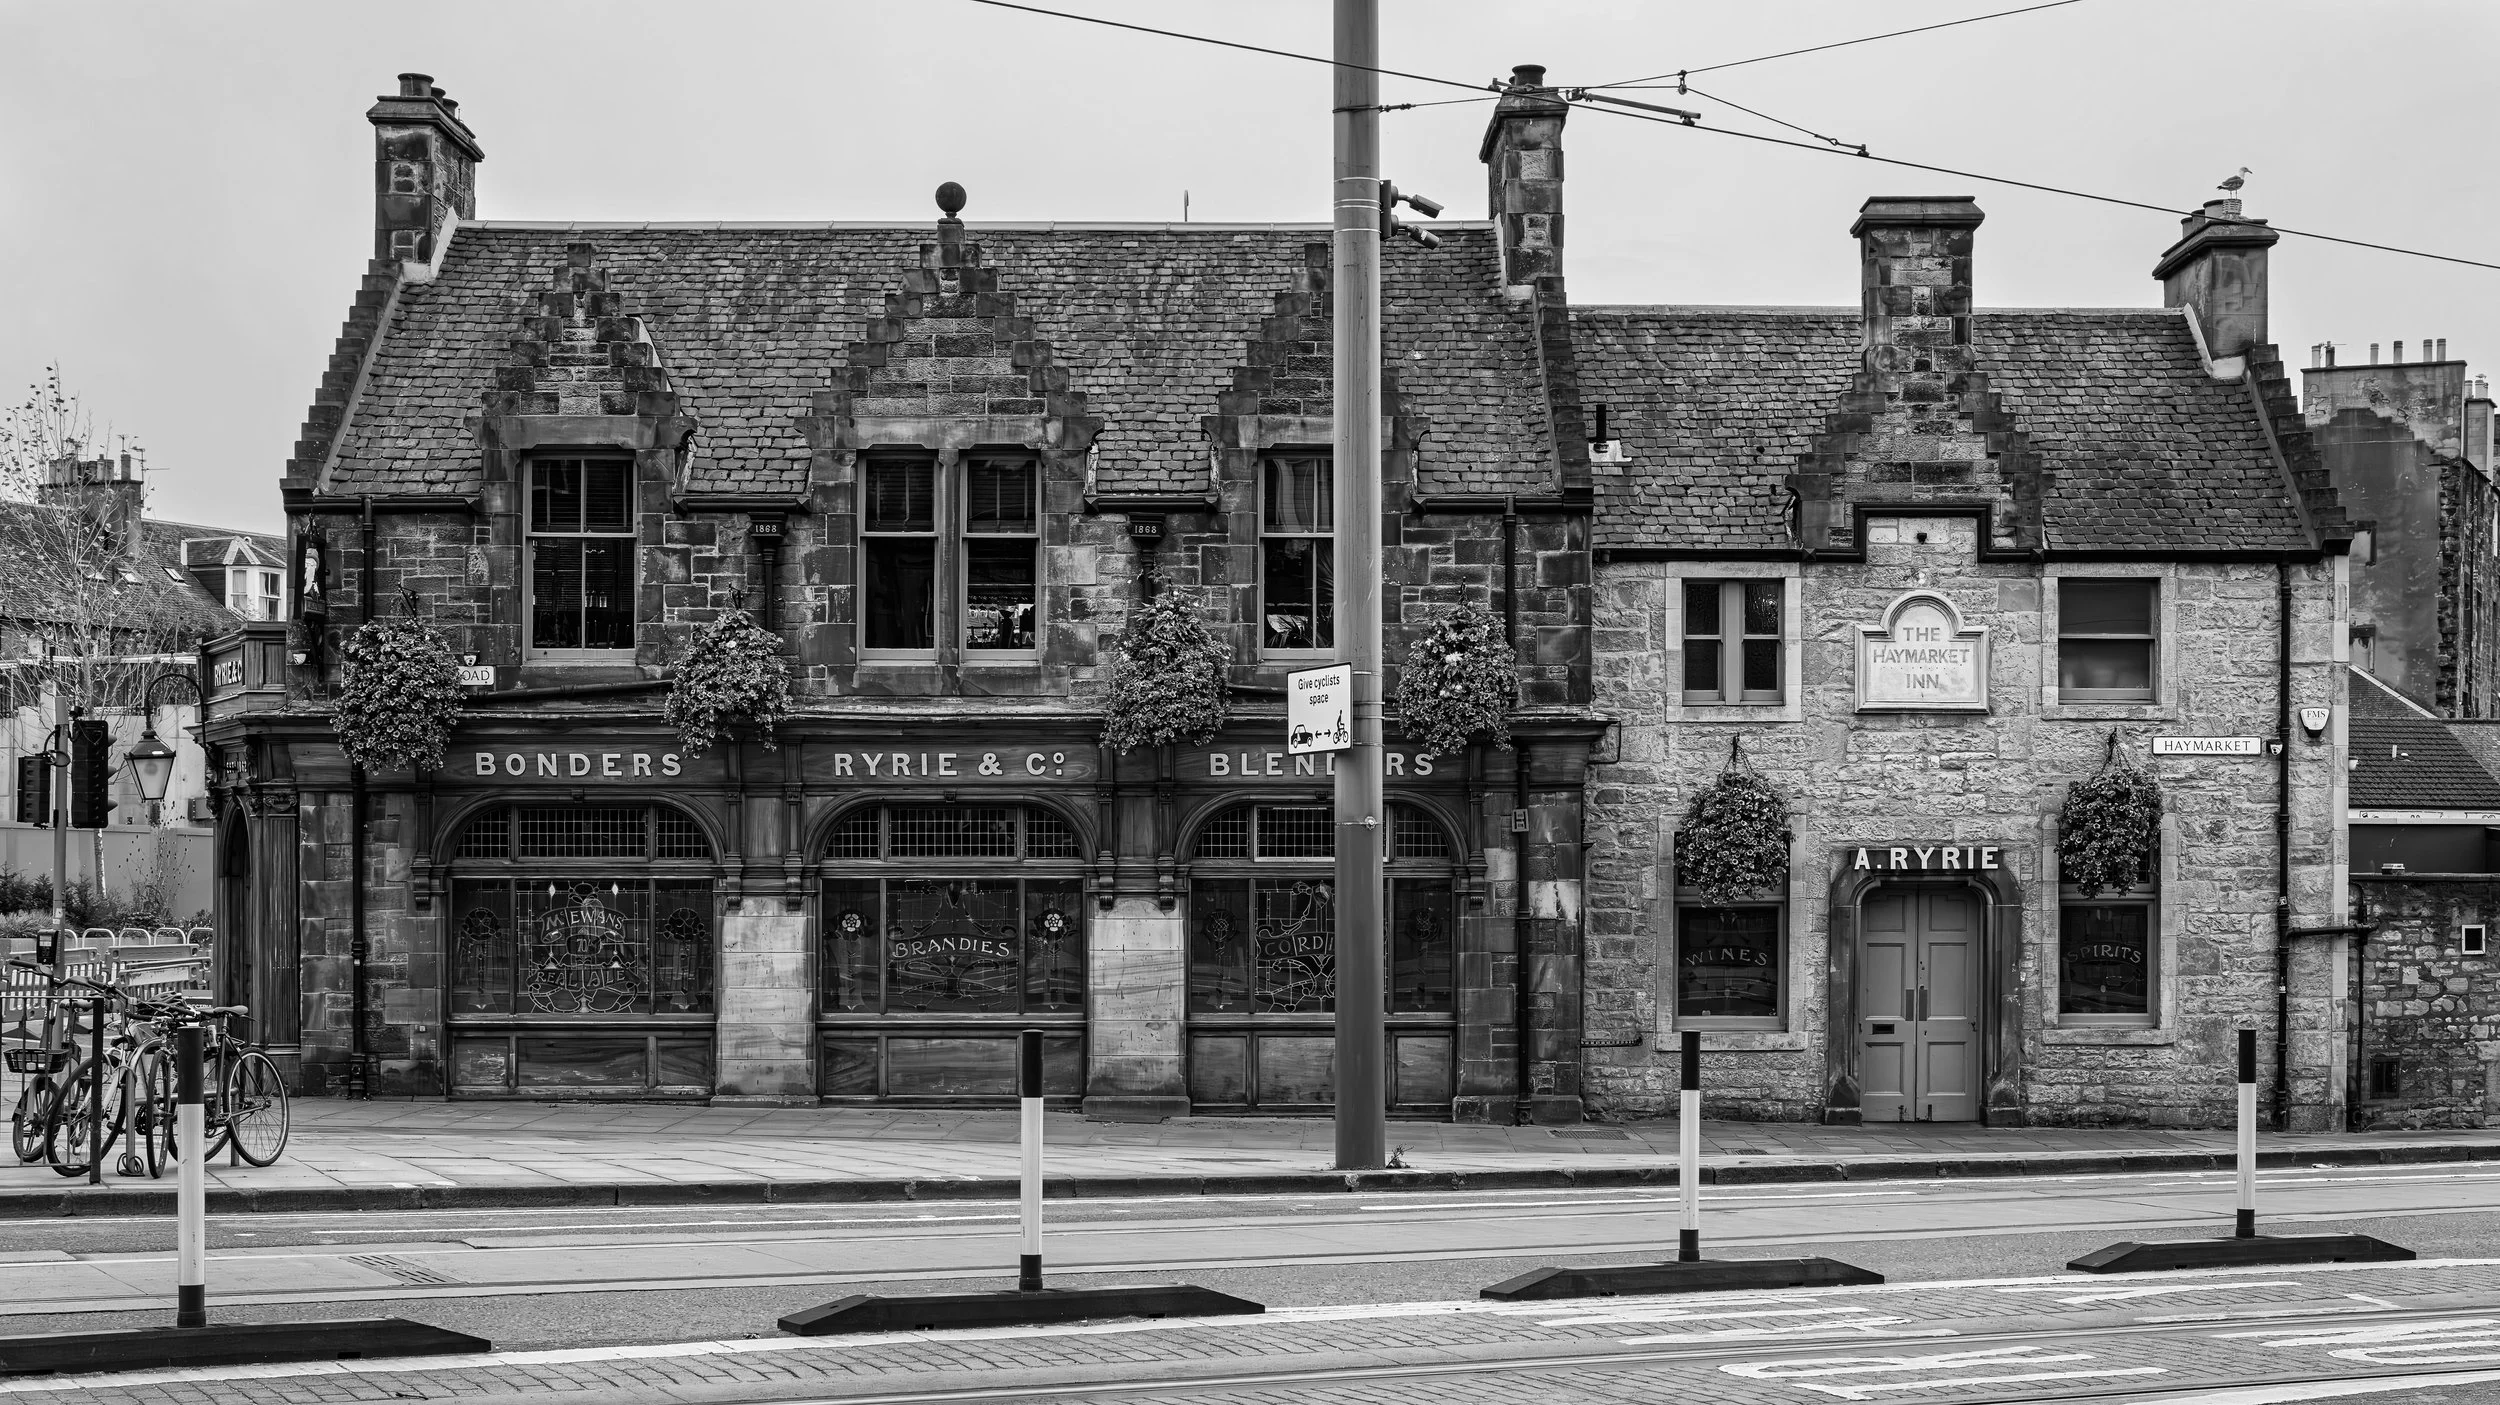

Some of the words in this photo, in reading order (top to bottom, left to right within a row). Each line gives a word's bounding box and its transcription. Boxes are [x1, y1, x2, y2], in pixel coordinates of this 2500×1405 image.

[755, 524, 777, 533] 1868
[1134, 525, 1157, 534] 1868
[1902, 627, 1941, 642] THE
[1873, 648, 1970, 664] HAYMARKET
[461, 669, 490, 681] OAD
[1298, 678, 1313, 690] Give
[1314, 674, 1340, 690] cyclists
[1906, 673, 1940, 689] INN
[1309, 693, 1329, 707] space
[2163, 739, 2251, 753] HAYMARKET
[475, 751, 682, 777] BONDERS
[835, 751, 959, 777] RYRIE
[978, 752, 1003, 777] &
[1209, 752, 1434, 777] BLENRS
[892, 937, 1010, 958] BRANDIES
[2066, 943, 2142, 964] SPIRITS
[1685, 947, 1768, 966] WINES
[536, 970, 578, 988] REAL
[587, 970, 626, 988] ALE
